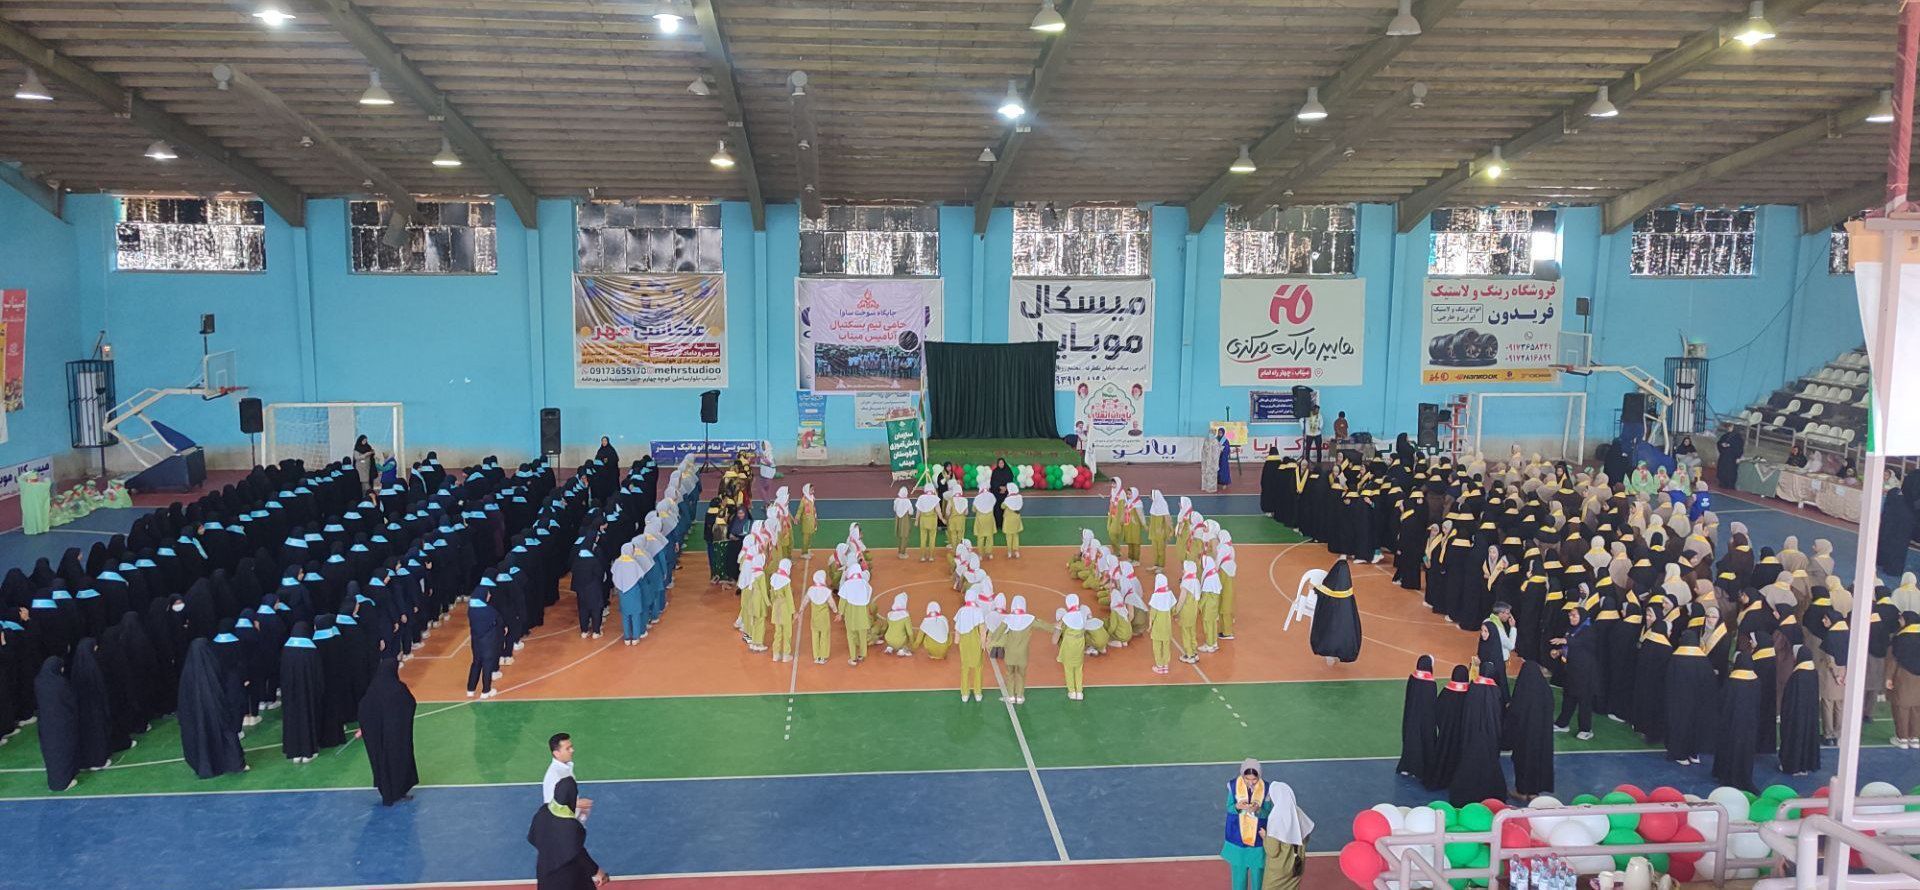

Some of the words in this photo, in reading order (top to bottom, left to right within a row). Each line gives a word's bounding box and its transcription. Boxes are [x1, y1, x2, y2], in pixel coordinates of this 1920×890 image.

[1431, 284, 1469, 299] لاستیک
[1473, 289, 1478, 300] و
[1481, 284, 1509, 300] رینگ
[1512, 283, 1556, 299] فروشگاه
[1020, 284, 1146, 321] میسکال
[1488, 303, 1554, 324] فریدون
[830, 320, 866, 331] بسکتبال
[866, 320, 881, 331] تیم
[883, 322, 907, 331] حامی
[838, 332, 863, 341] میناب
[1226, 329, 1279, 359] مرکزی
[1271, 327, 1317, 361] مارکت
[654, 366, 721, 374] mehrstudioo
